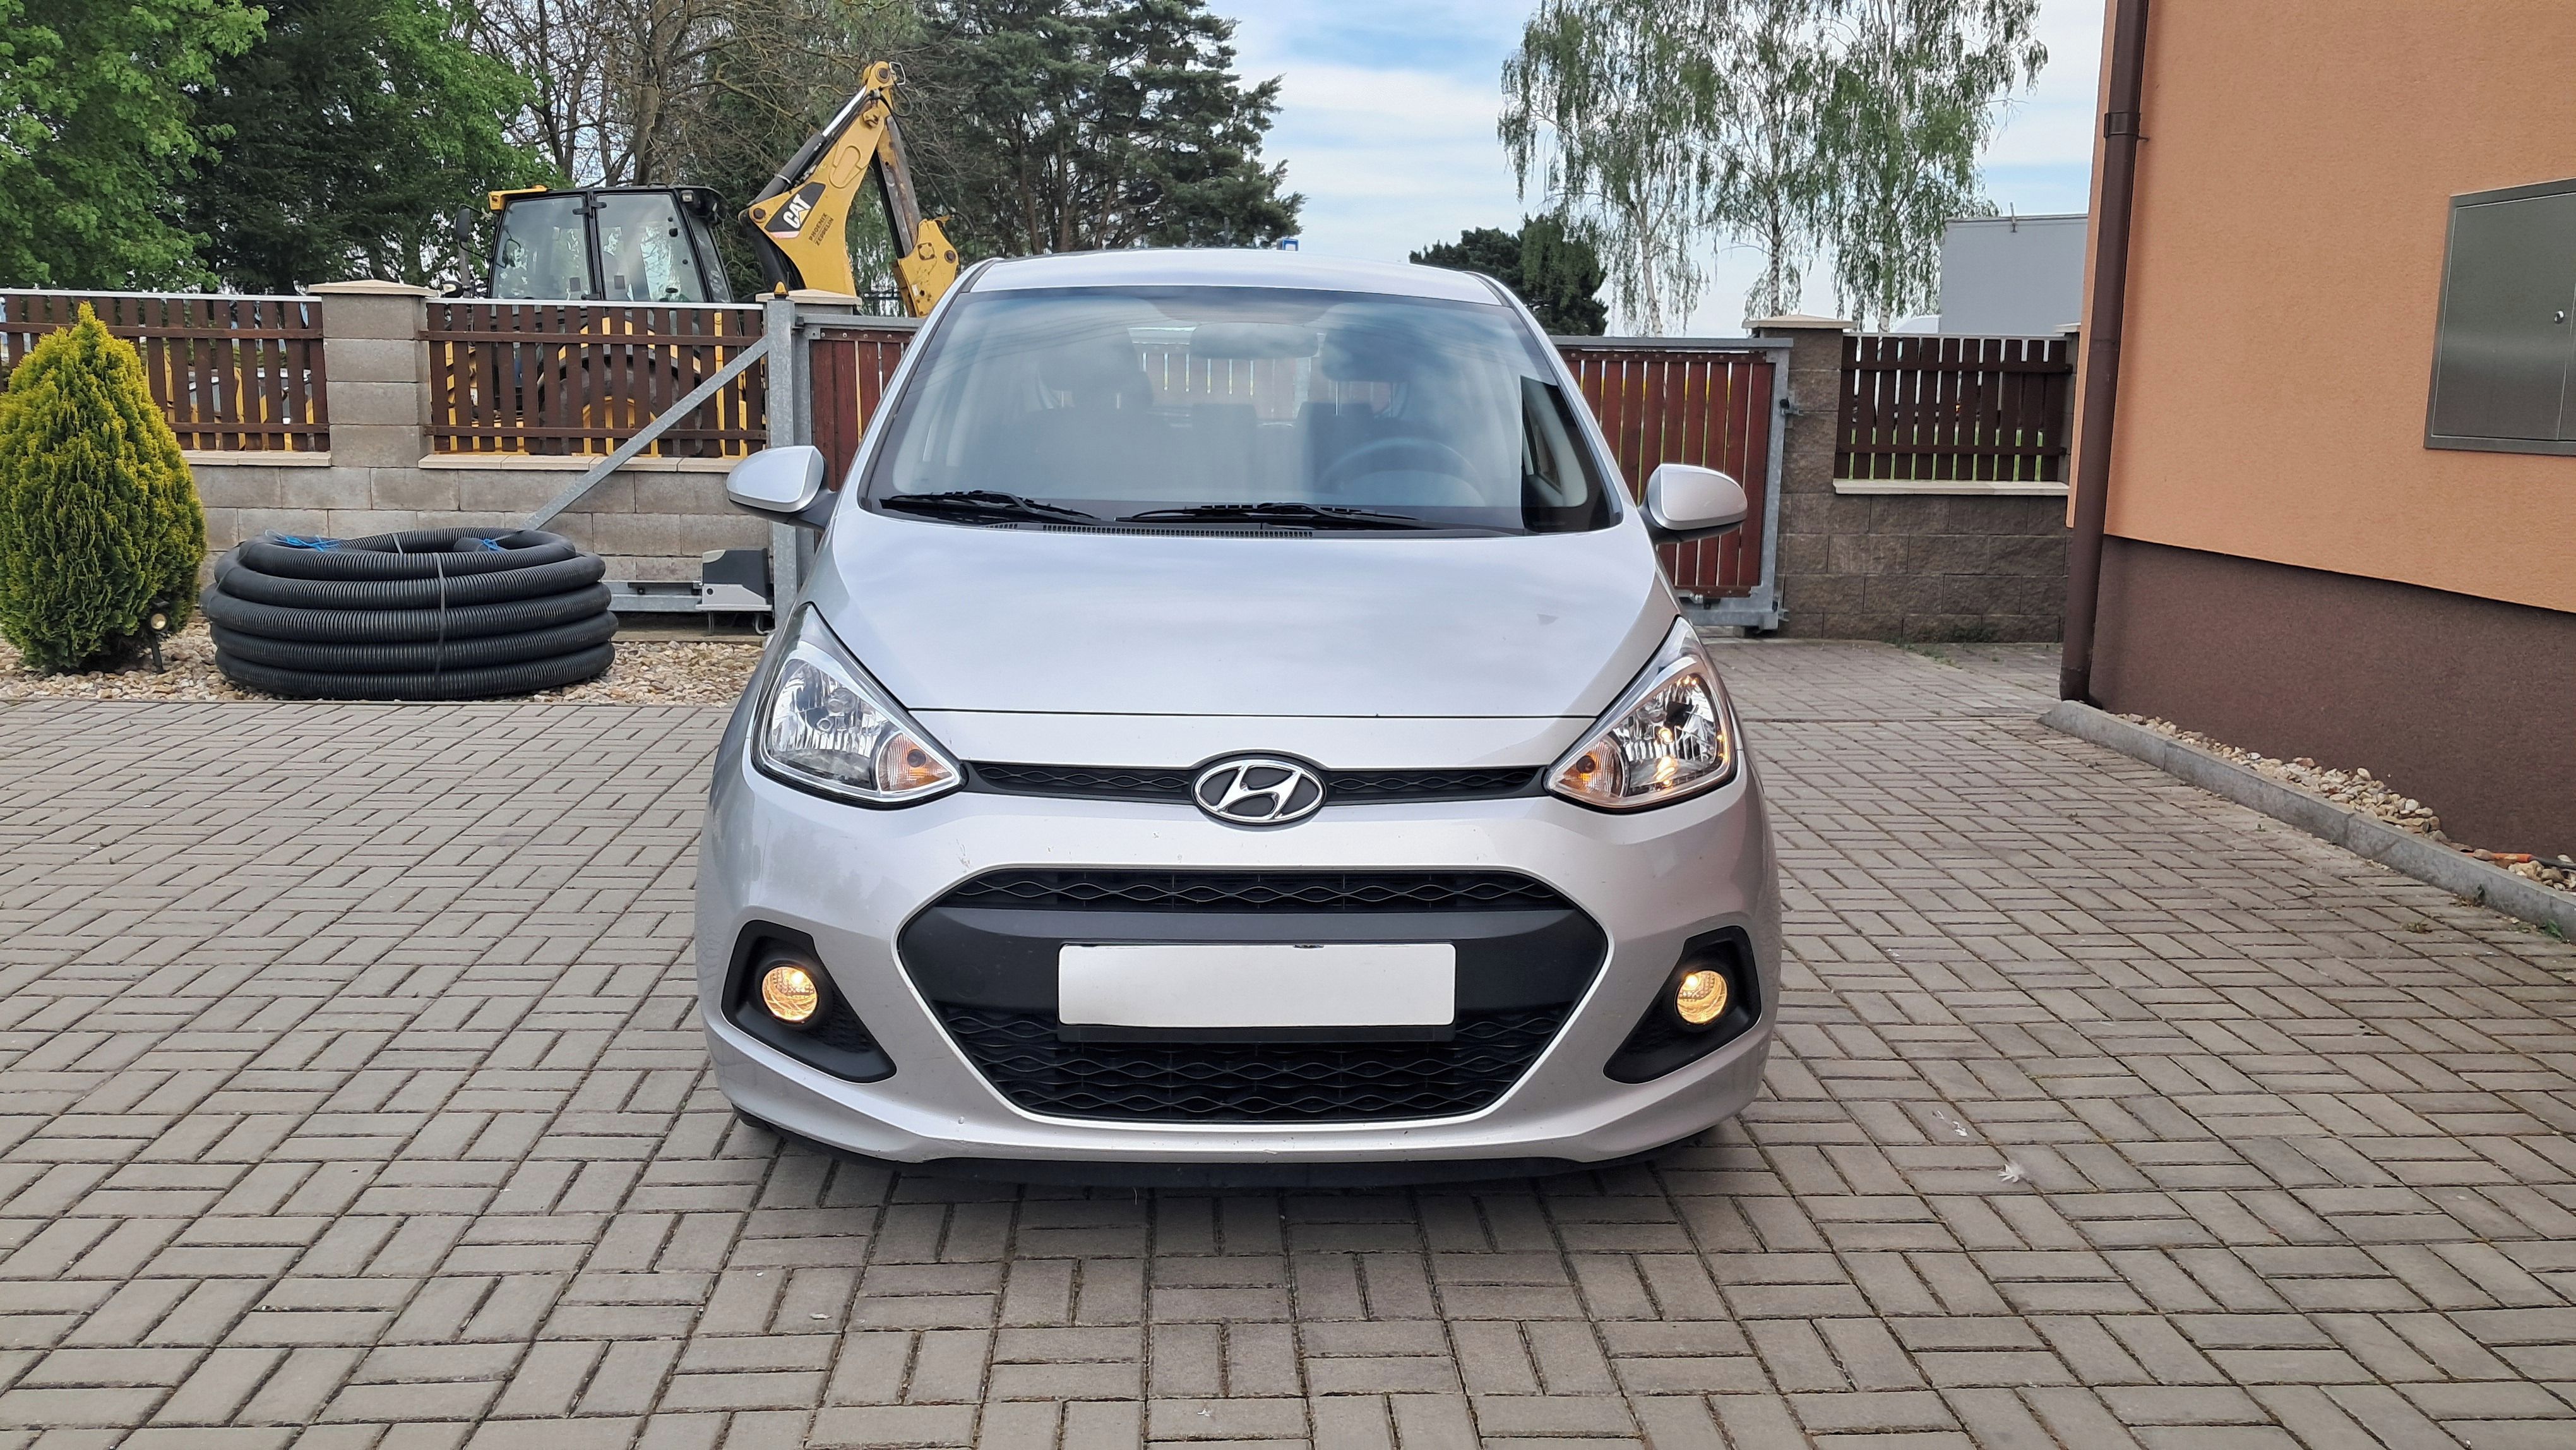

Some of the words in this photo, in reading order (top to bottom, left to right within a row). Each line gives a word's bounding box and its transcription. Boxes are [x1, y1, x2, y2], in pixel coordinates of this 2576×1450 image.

[783, 193, 811, 229] CAT
[809, 212, 828, 241] PHOENIX
[815, 217, 834, 246] ZEPPELIN
